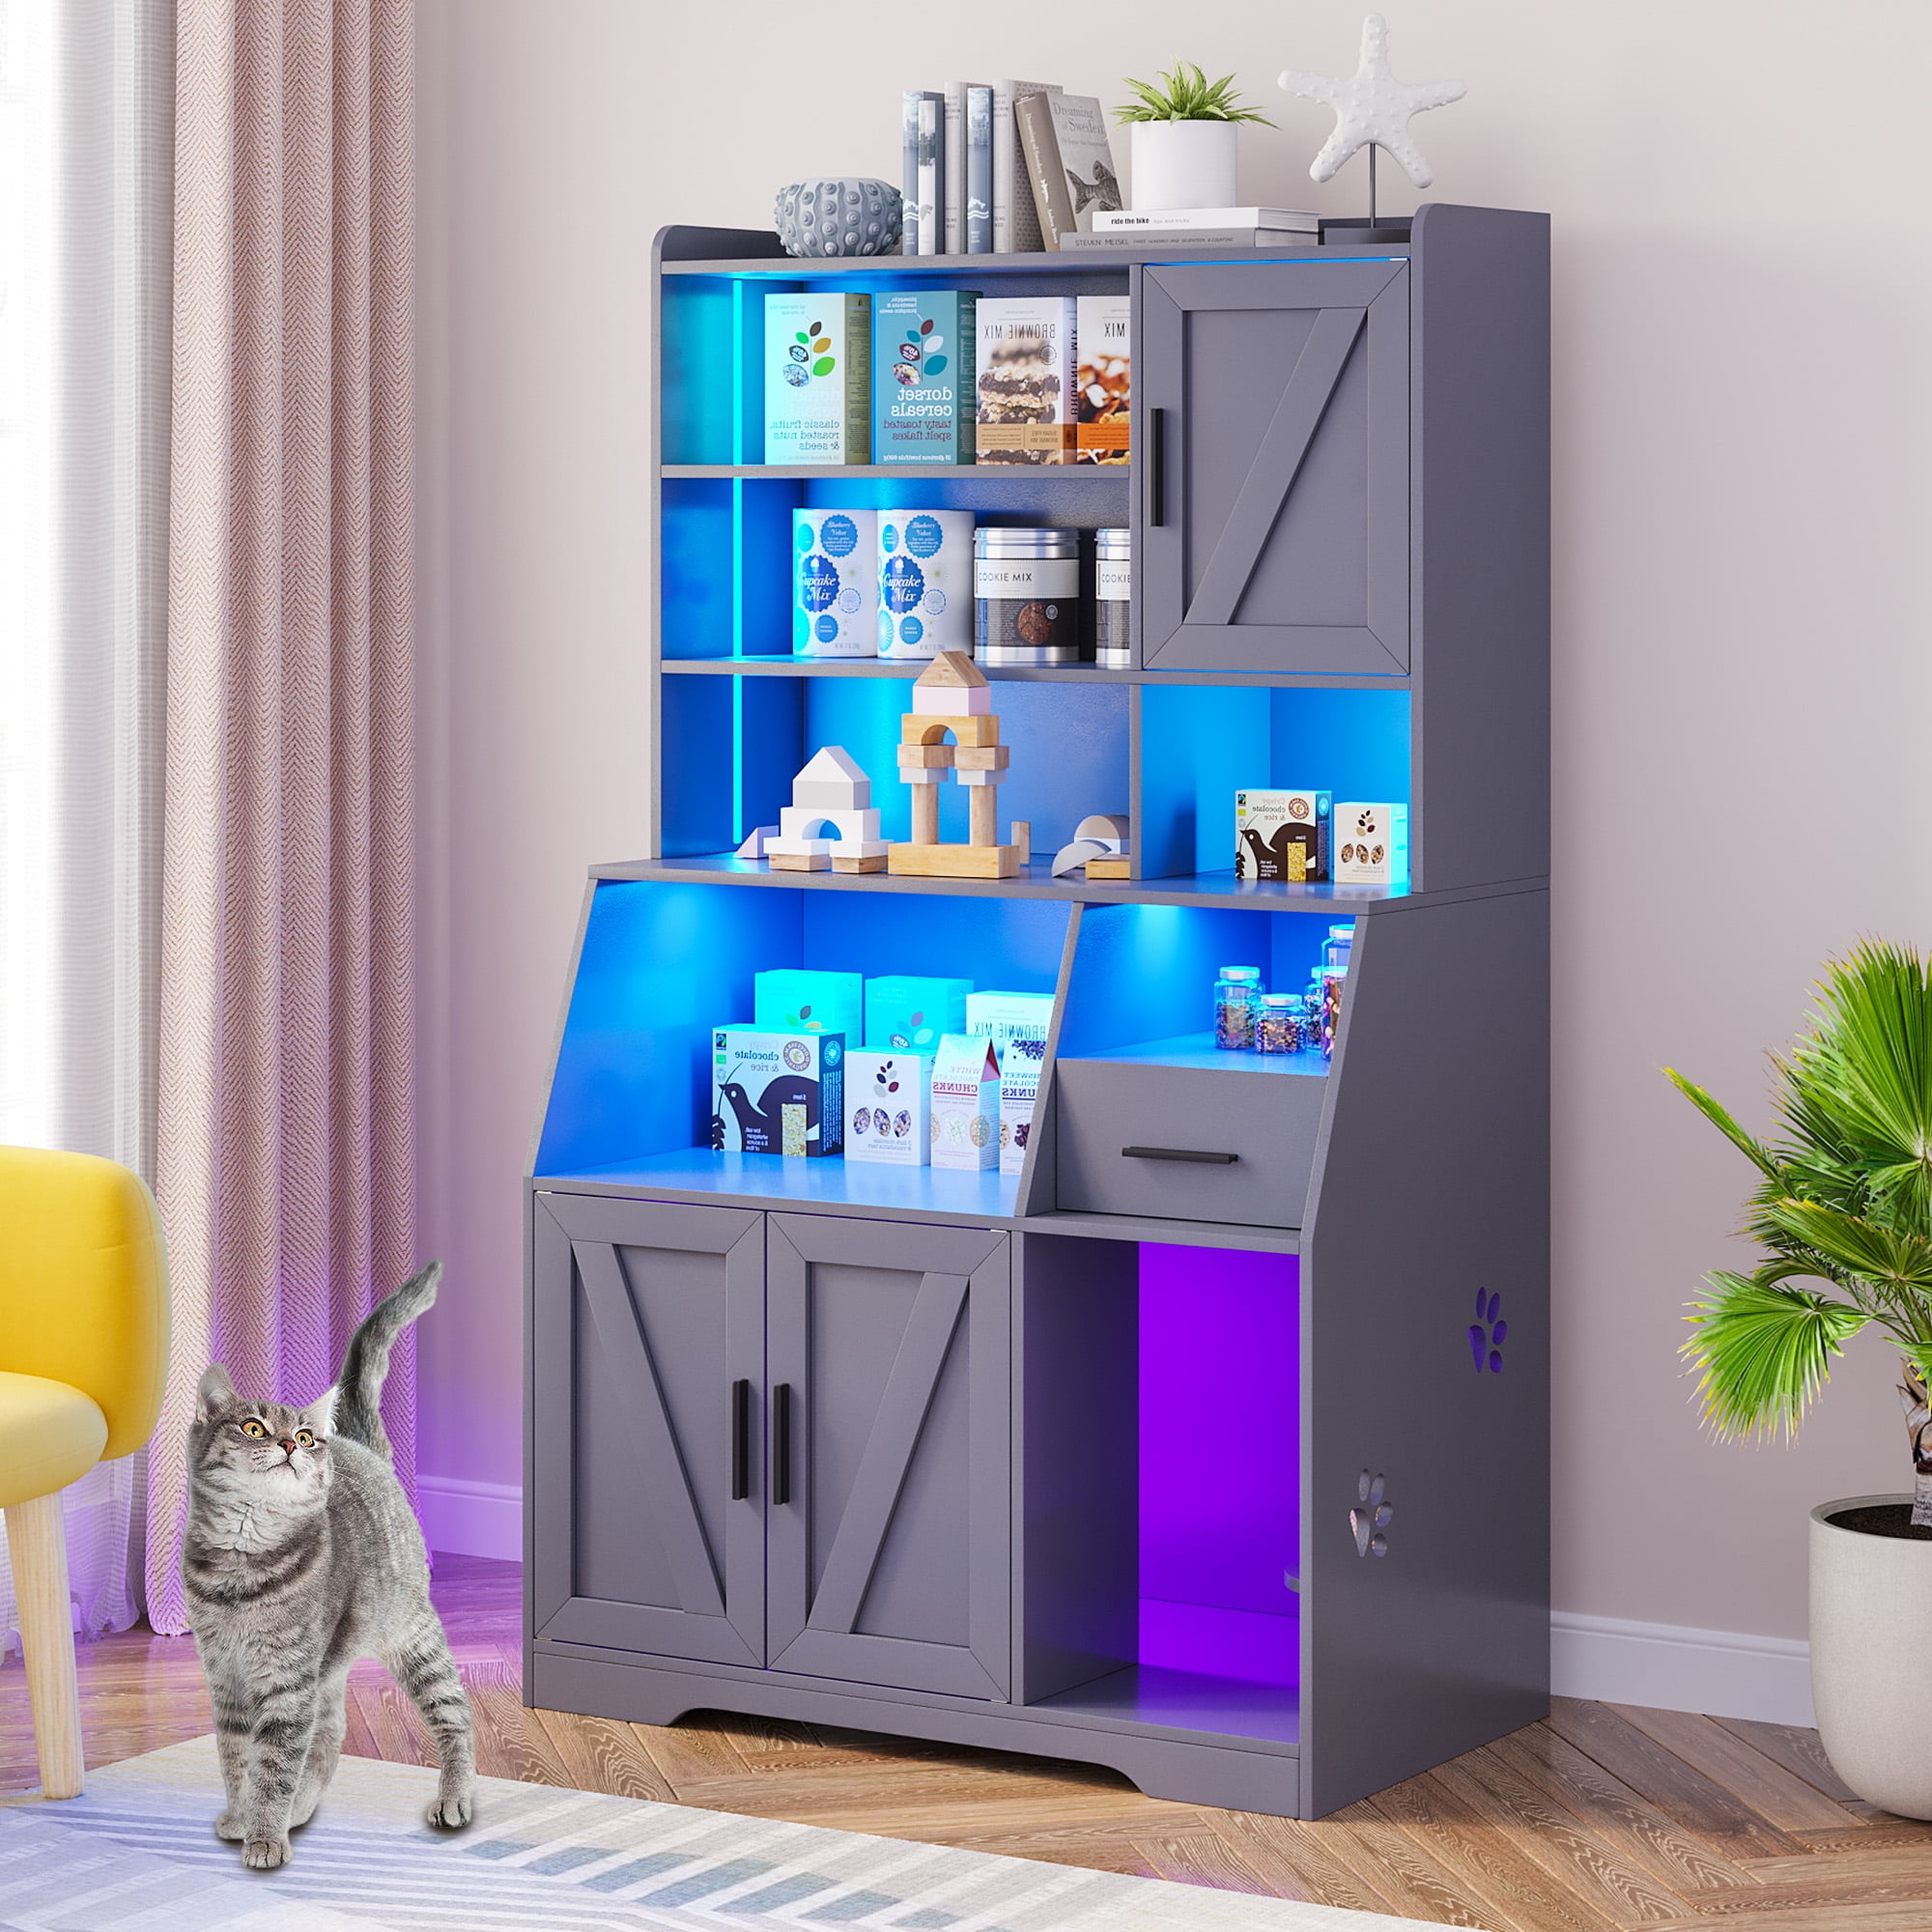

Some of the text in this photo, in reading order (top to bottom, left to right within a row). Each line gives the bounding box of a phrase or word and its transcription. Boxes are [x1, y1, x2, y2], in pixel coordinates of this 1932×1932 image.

[1053, 101, 1094, 119] Dreaming
[1067, 117, 1106, 134] Sweden
[883, 572, 922, 591] Cupcake
[979, 573, 1033, 582] COOKIE MIX
[807, 586, 832, 602] Mix
[891, 586, 917, 603] Mix
